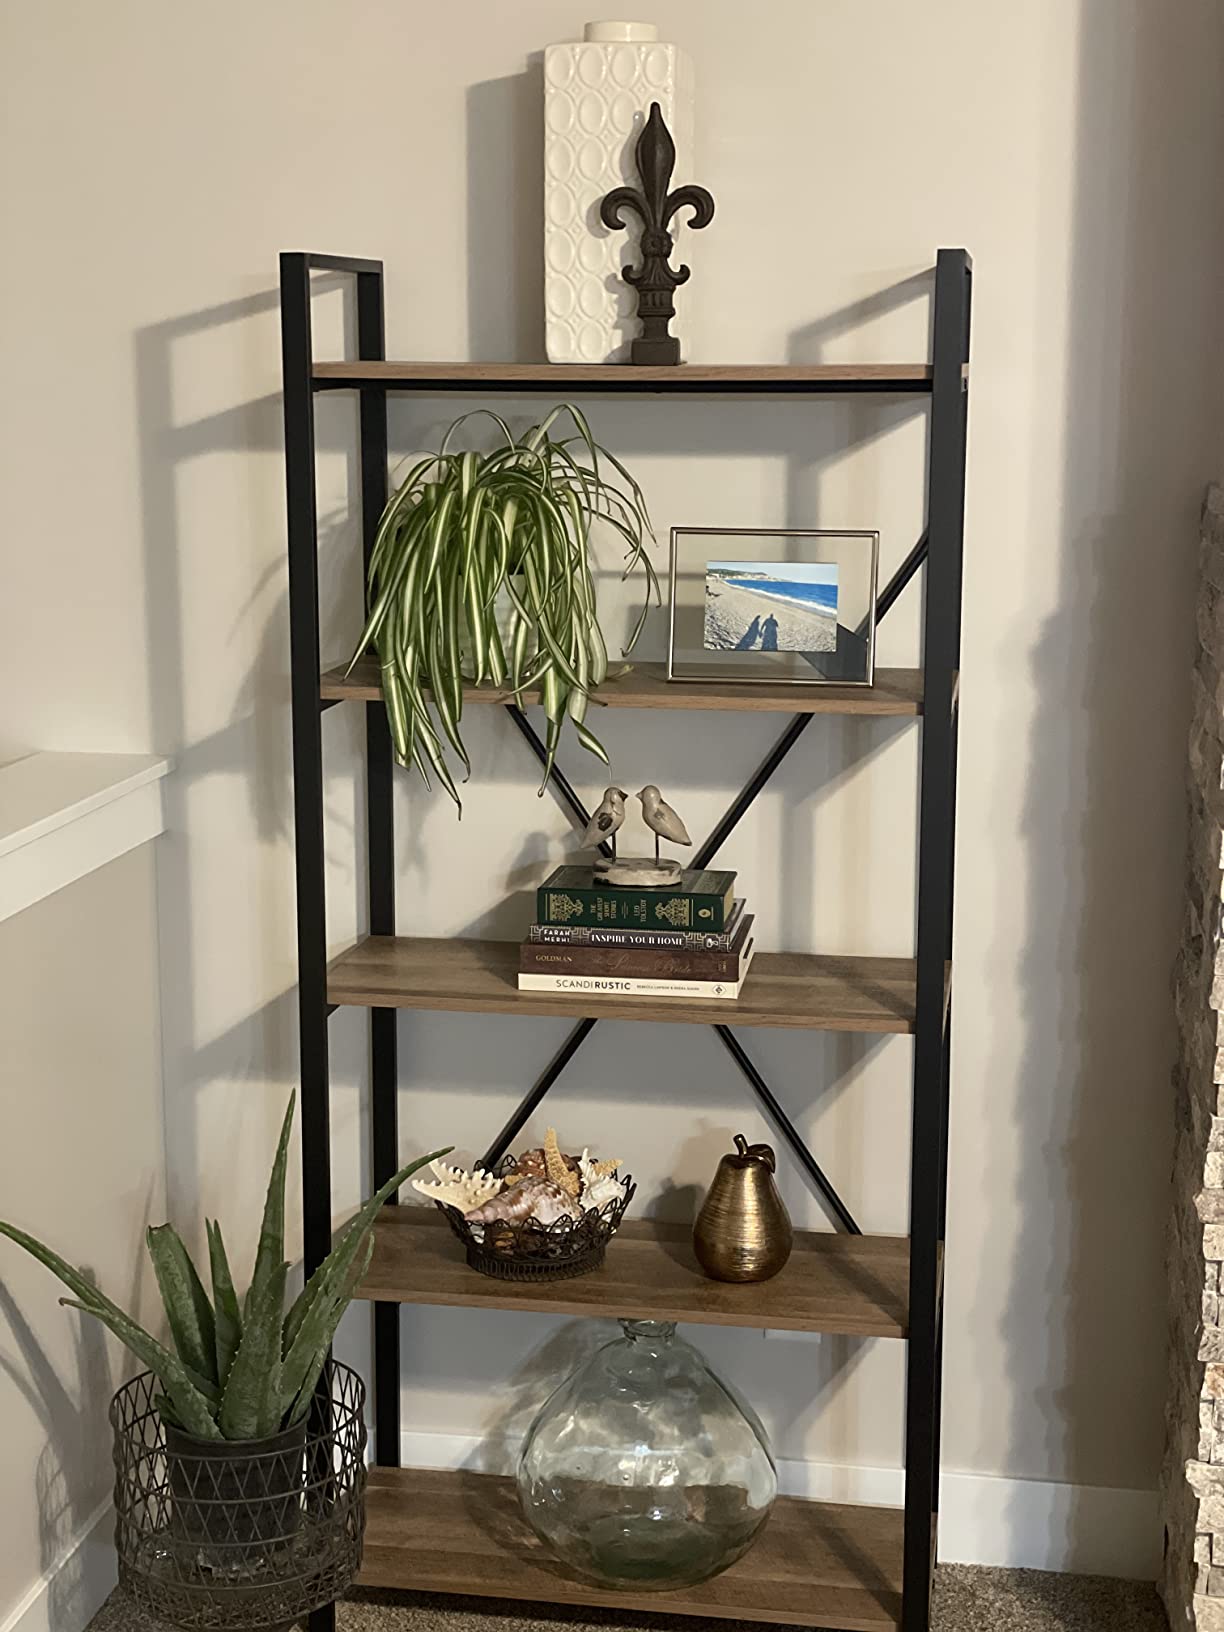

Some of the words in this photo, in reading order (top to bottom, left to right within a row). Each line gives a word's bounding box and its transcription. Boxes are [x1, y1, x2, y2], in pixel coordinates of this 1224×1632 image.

[543, 928, 570, 936] FARAH
[591, 934, 626, 943] INSPIRE
[629, 936, 655, 945] YOUR
[657, 937, 683, 946] HOME
[535, 954, 573, 962] GOLDMAN
[555, 979, 631, 990] SCANDIRUSTIC
